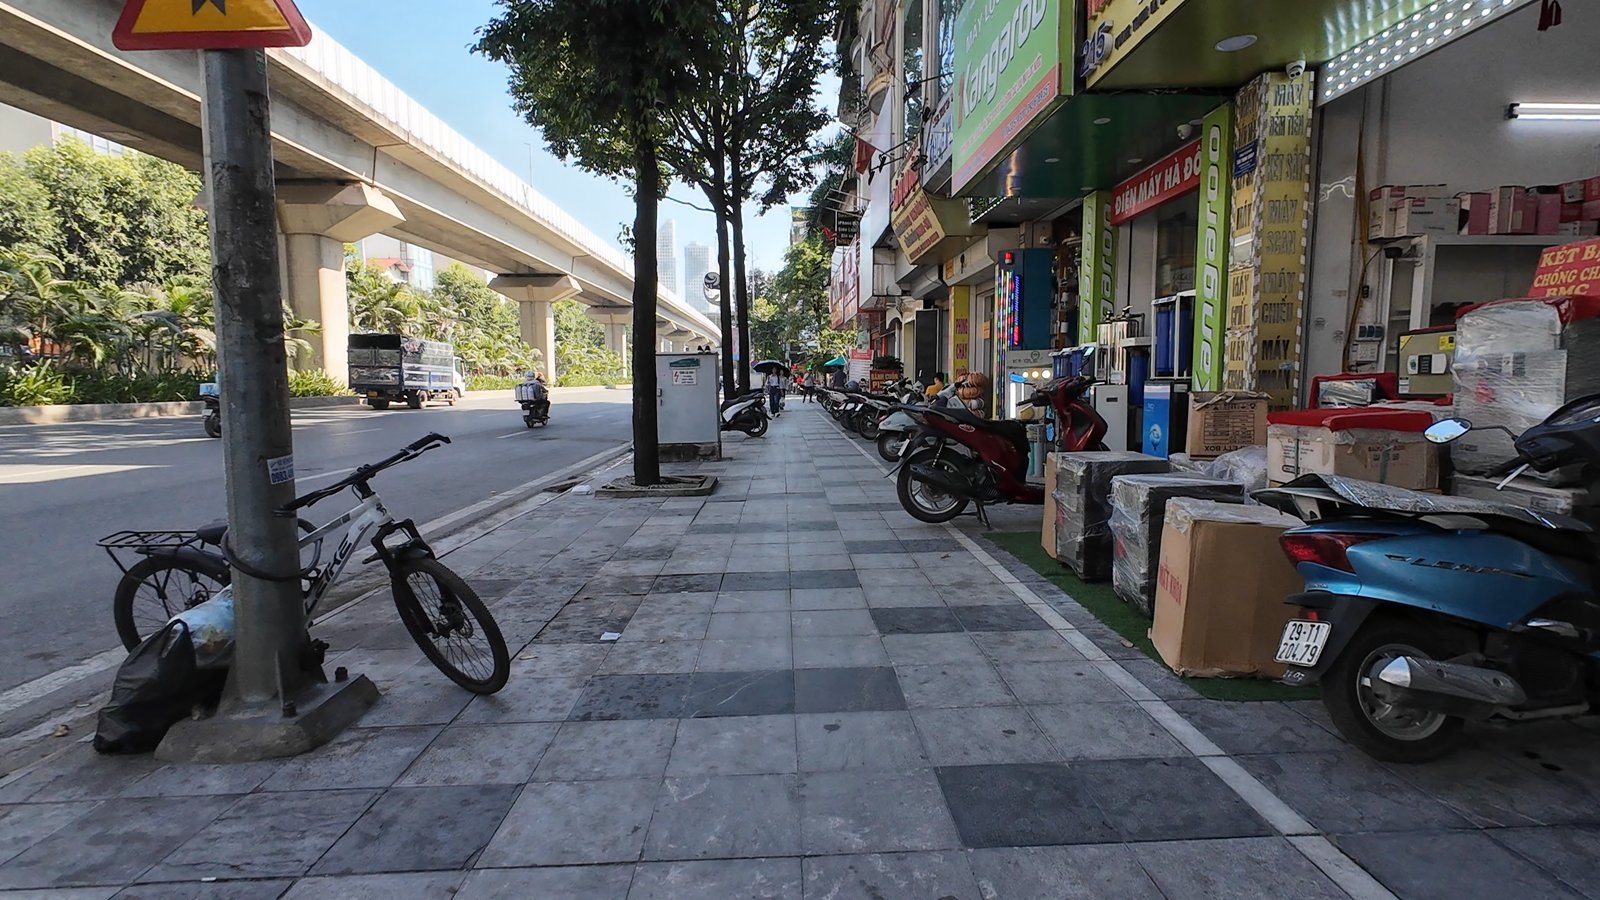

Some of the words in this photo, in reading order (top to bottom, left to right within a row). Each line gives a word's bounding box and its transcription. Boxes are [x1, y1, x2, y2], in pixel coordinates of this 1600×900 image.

[1080, 20, 1113, 78] 215
[958, 0, 1047, 128] Kangaroo
[1115, 185, 1137, 215] ĐIỆN
[1137, 170, 1163, 205] MÁY
[1164, 157, 1181, 191] HÀ
[1268, 195, 1298, 224] MÁY
[1540, 247, 1580, 268] KÉT
[1263, 267, 1295, 294] MÁY
[1533, 266, 1578, 287] CHỐNG
[1545, 284, 1590, 298] BMC
[1262, 335, 1290, 360] MÁY
[1288, 622, 1321, 643] 29-T1
[1278, 643, 1319, 663] 204.79
